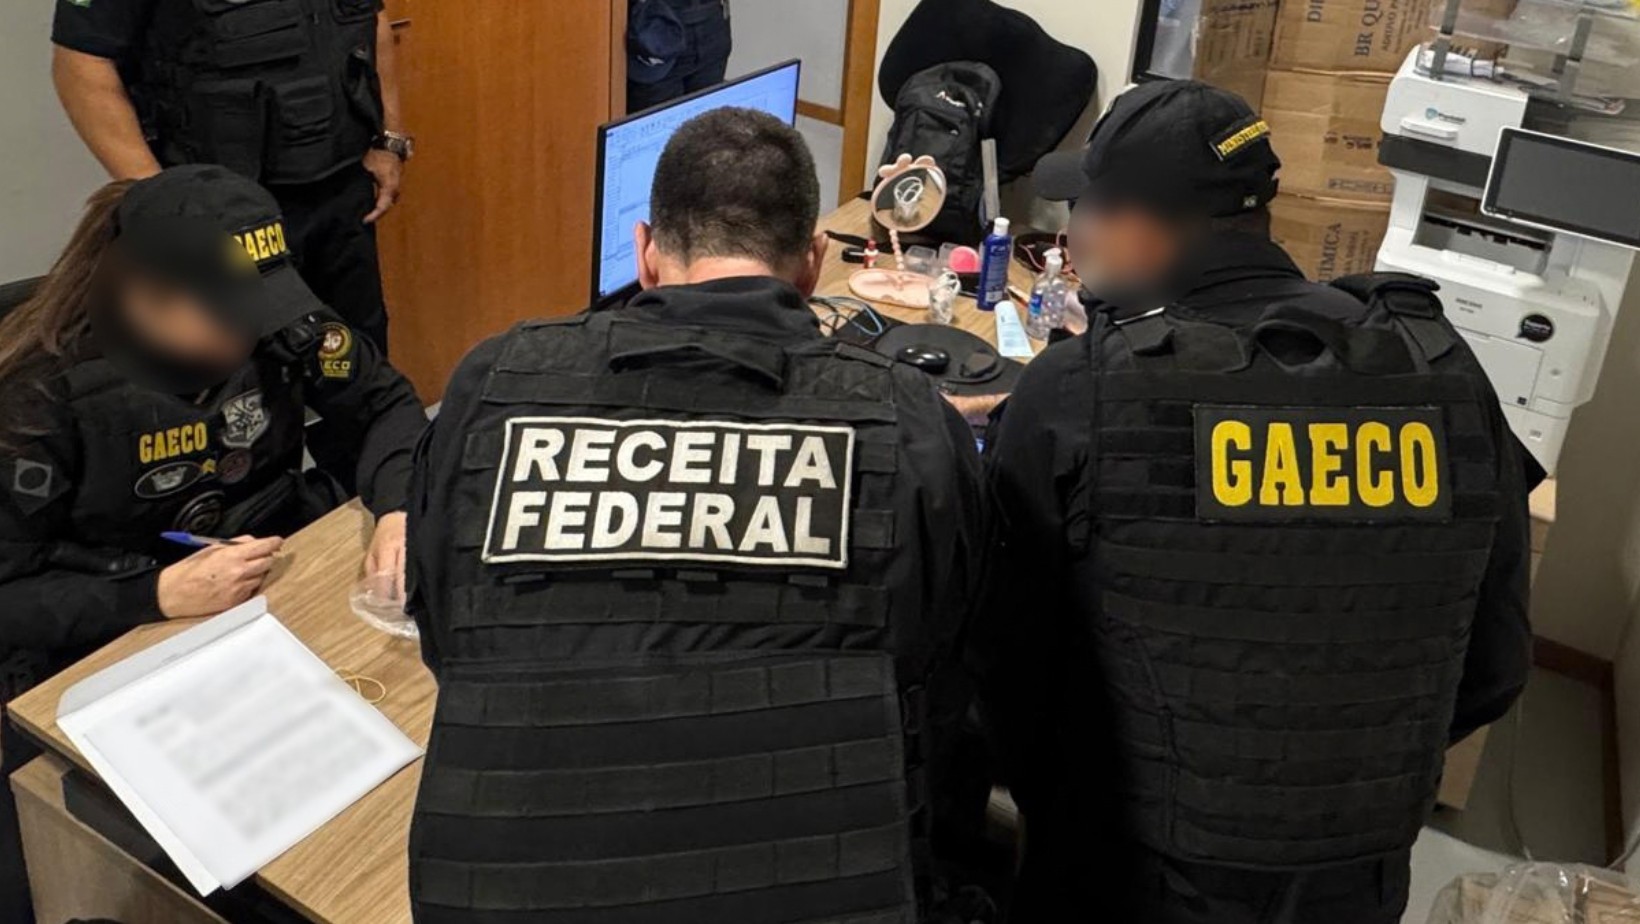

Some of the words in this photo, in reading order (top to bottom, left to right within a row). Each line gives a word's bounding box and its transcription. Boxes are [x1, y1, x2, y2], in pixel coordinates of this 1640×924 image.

[1354, 32, 1374, 56] BR
[234, 223, 286, 261] AECO
[139, 422, 208, 464] GAECO
[512, 428, 837, 489] RECEITA
[1211, 420, 1439, 507] GAECO
[502, 491, 831, 555] FEDERAL
